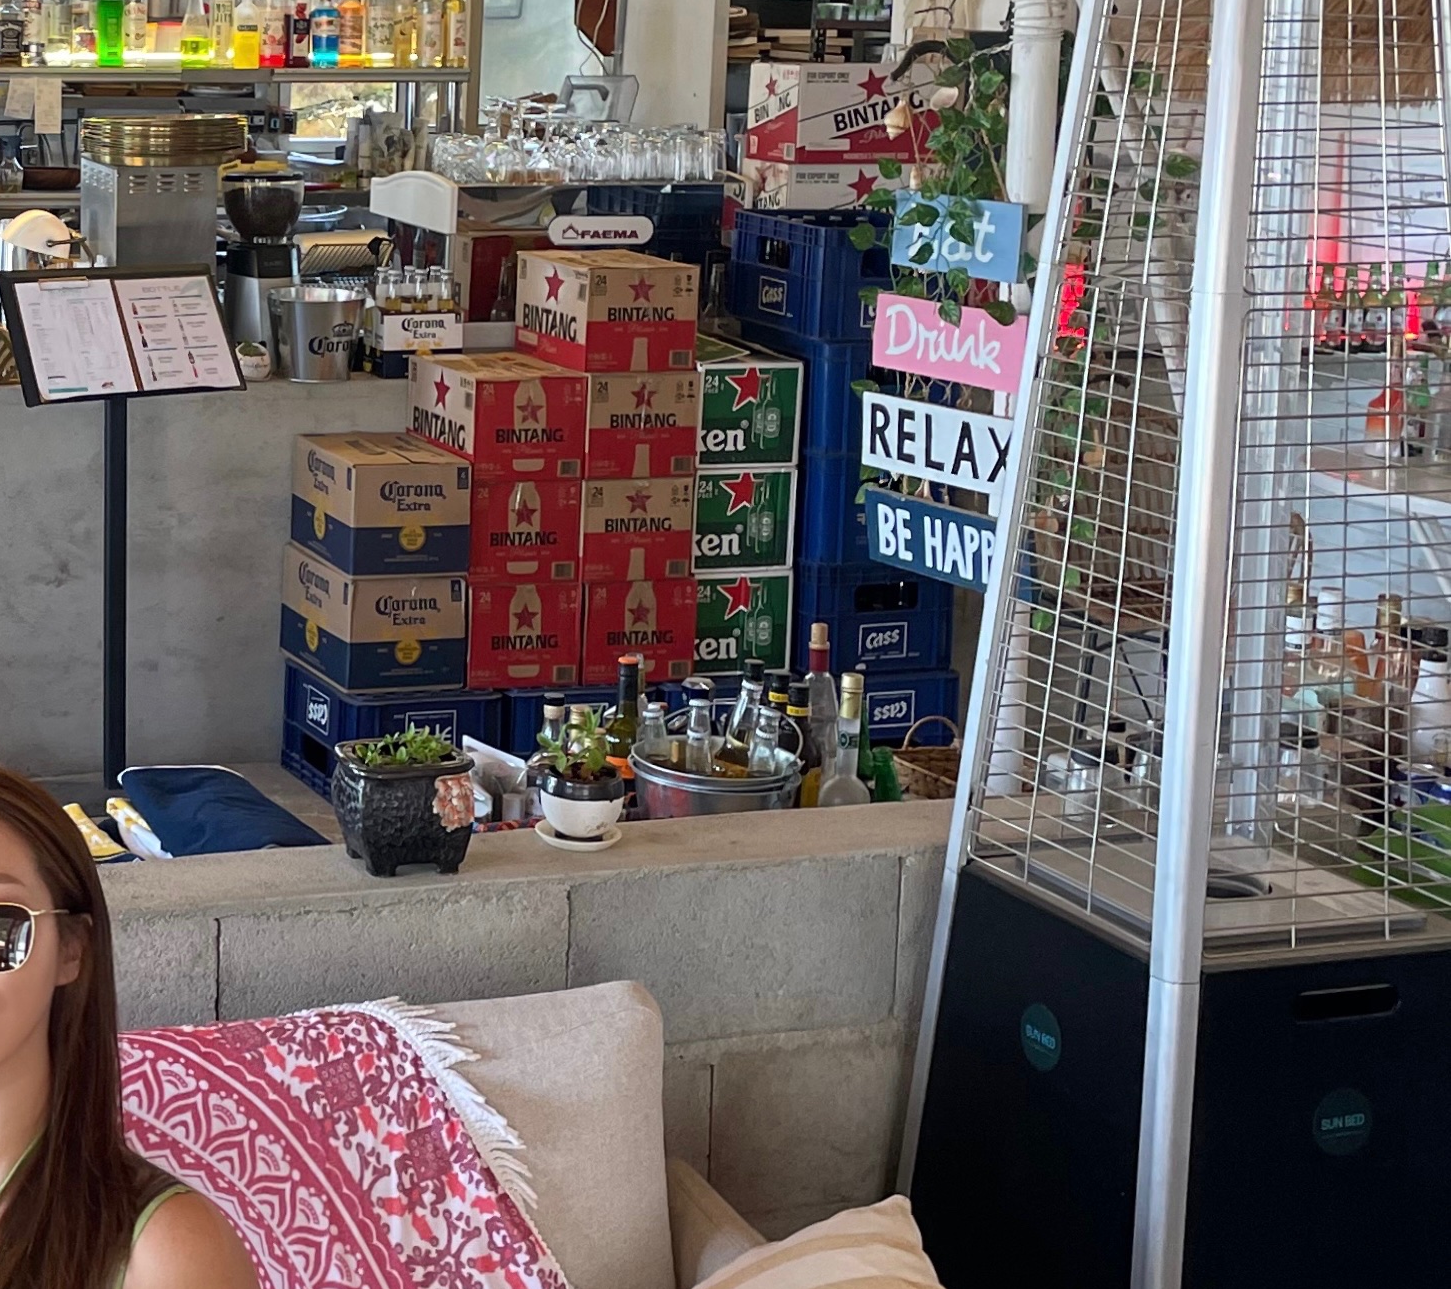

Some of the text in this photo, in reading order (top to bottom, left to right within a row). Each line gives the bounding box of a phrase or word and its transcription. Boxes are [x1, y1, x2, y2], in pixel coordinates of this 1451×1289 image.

[833, 90, 924, 132] BINTAG
[580, 230, 639, 240] FAEMA
[596, 274, 607, 286] 24
[607, 306, 675, 322] BINTANG
[401, 318, 447, 334] Corona
[523, 303, 577, 342] BINTANG
[413, 330, 437, 339] Extra
[885, 304, 1001, 374] Drink
[309, 336, 349, 358] Coro
[597, 382, 609, 393] 24
[705, 375, 719, 388] 24
[413, 406, 467, 450] BINTANG
[610, 414, 677, 429] BINTANG
[495, 428, 565, 444] BINTANG
[869, 402, 1011, 483] RELAX
[379, 481, 447, 504] Corona
[591, 486, 603, 498] 24
[699, 480, 713, 493] 24
[397, 498, 431, 512] Extra
[605, 518, 672, 533] BINTANG
[490, 532, 557, 548] BINTANG
[877, 502, 997, 585] BE HAPP
[479, 592, 491, 604] 24
[697, 586, 711, 598] 24
[375, 594, 441, 618] Corona
[393, 613, 426, 626] Extra
[491, 634, 559, 650] BINTANG
[607, 630, 674, 646] BINTANG
[865, 629, 900, 650] Cass
